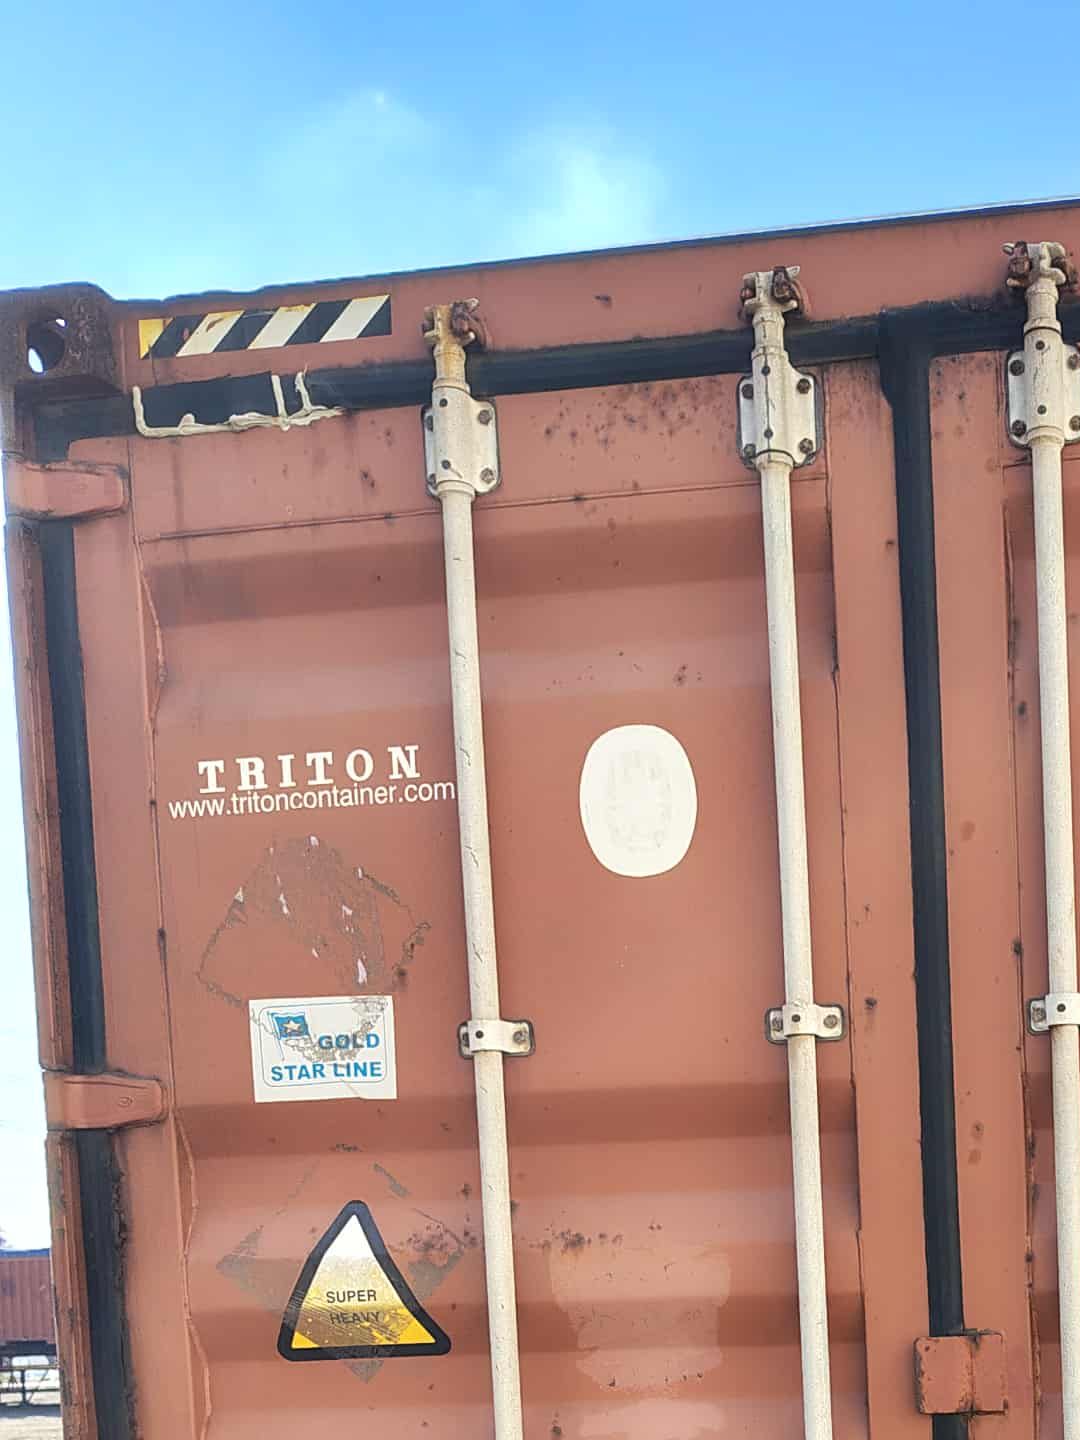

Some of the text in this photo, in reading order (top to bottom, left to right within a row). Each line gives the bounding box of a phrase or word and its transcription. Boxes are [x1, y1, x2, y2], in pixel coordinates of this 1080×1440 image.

[197, 744, 421, 794] TRITON
[168, 781, 457, 820] www.tritoncontainer.com
[318, 1033, 380, 1049] GOLD
[271, 1062, 383, 1082] STAR LINE
[326, 1289, 377, 1303] SUPER
[330, 1312, 380, 1324] HEAVY
